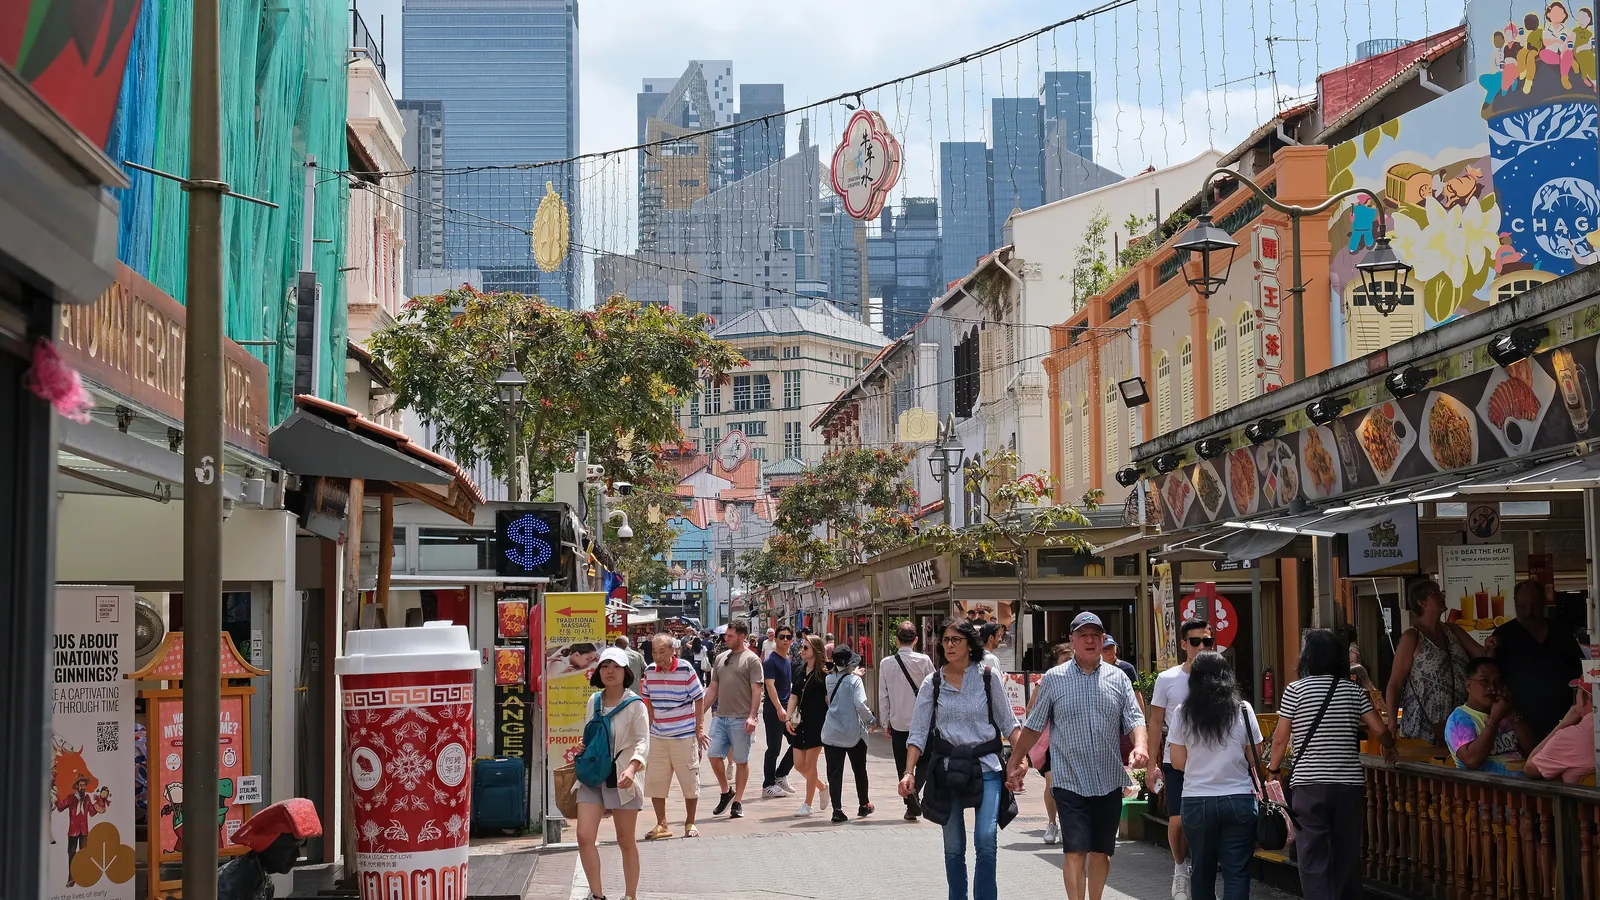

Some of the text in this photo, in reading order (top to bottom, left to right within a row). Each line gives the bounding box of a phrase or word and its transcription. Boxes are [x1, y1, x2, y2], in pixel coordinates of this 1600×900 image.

[860, 129, 875, 188] 牛车水
[505, 514, 552, 571] $
[1363, 549, 1404, 558] SINGHA
[79, 634, 118, 649] ABOUT
[52, 667, 118, 683] GINNINGS?
[60, 688, 67, 701] A
[68, 686, 119, 700] CAPTIVATING
[59, 701, 100, 714] THROUGH
[102, 700, 119, 712] TIME
[225, 712, 230, 721] A
[93, 890, 108, 898] early
